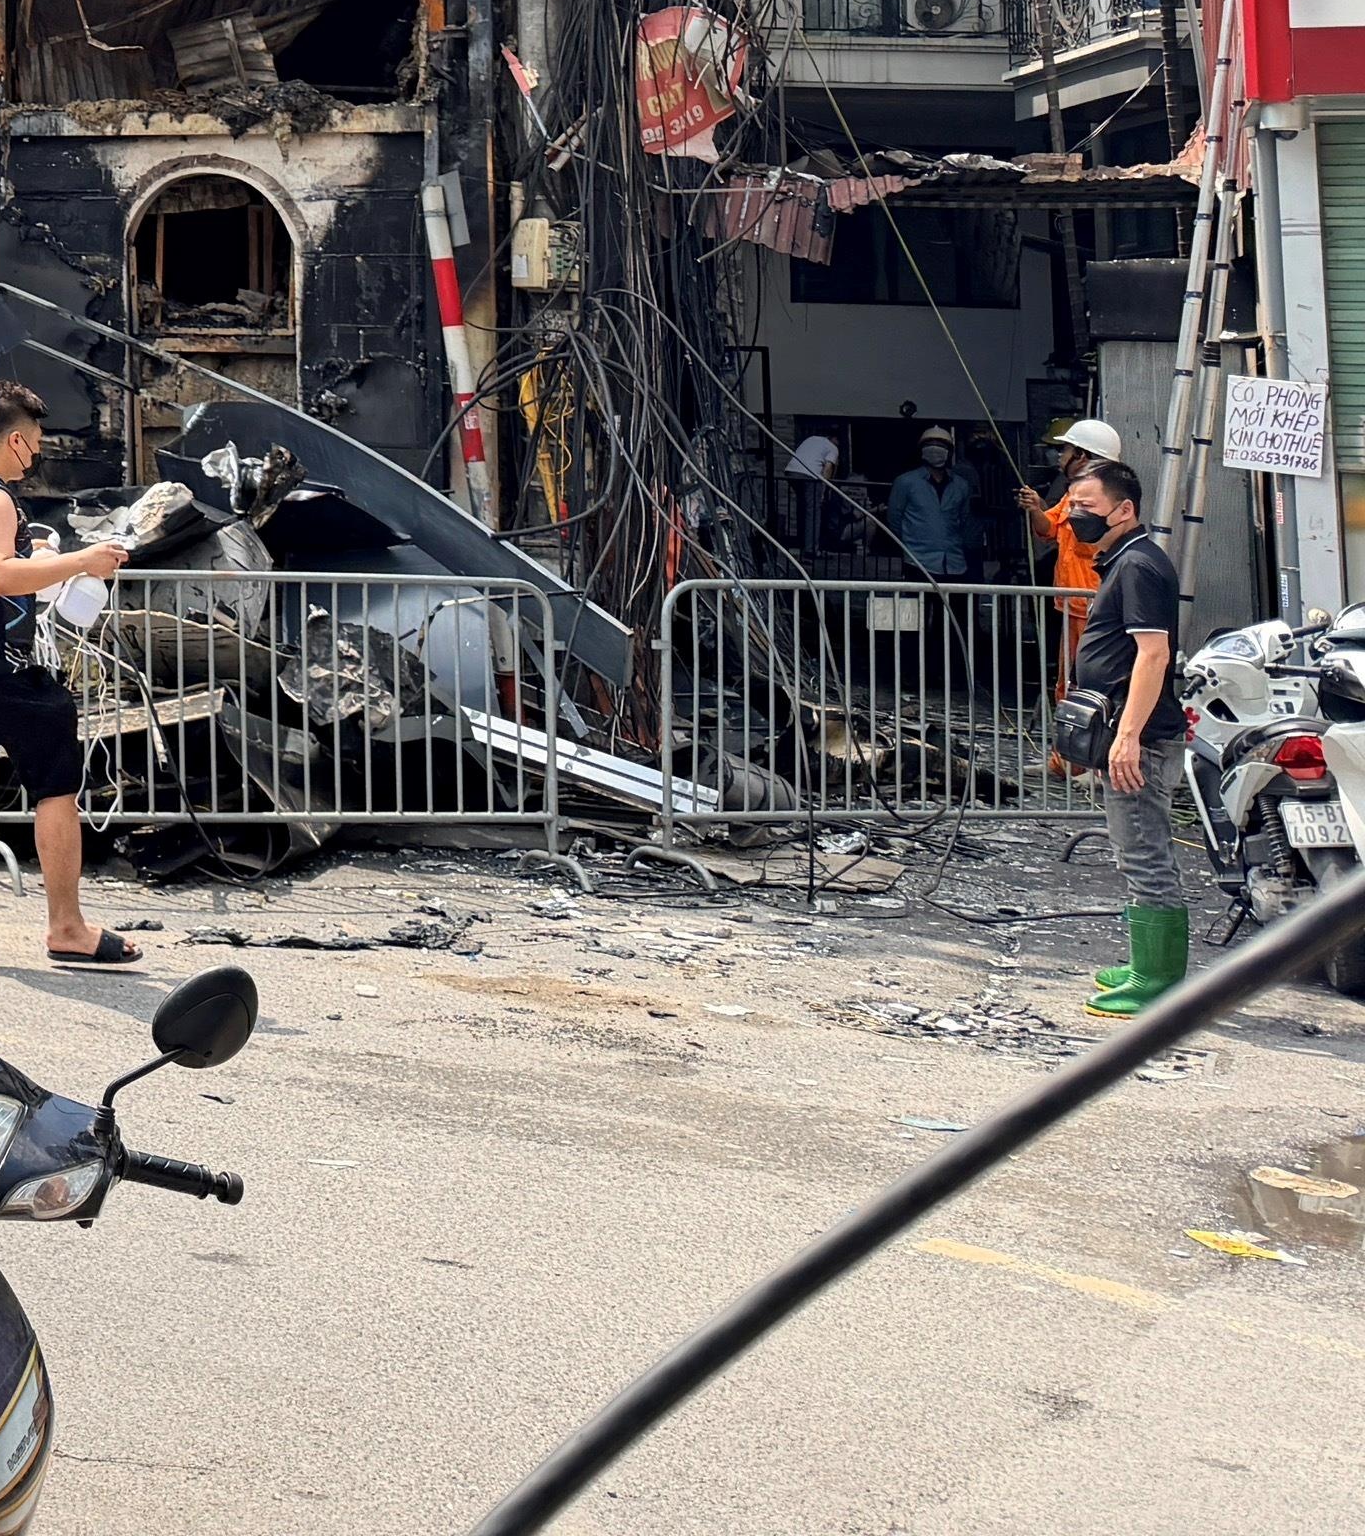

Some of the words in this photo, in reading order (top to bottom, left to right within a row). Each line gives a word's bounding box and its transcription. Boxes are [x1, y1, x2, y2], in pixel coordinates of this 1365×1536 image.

[1265, 383, 1323, 411] PHÒNG
[1229, 401, 1266, 427] MỚI
[1270, 409, 1320, 433] KHÉP
[1293, 824, 1353, 844] 409.2
